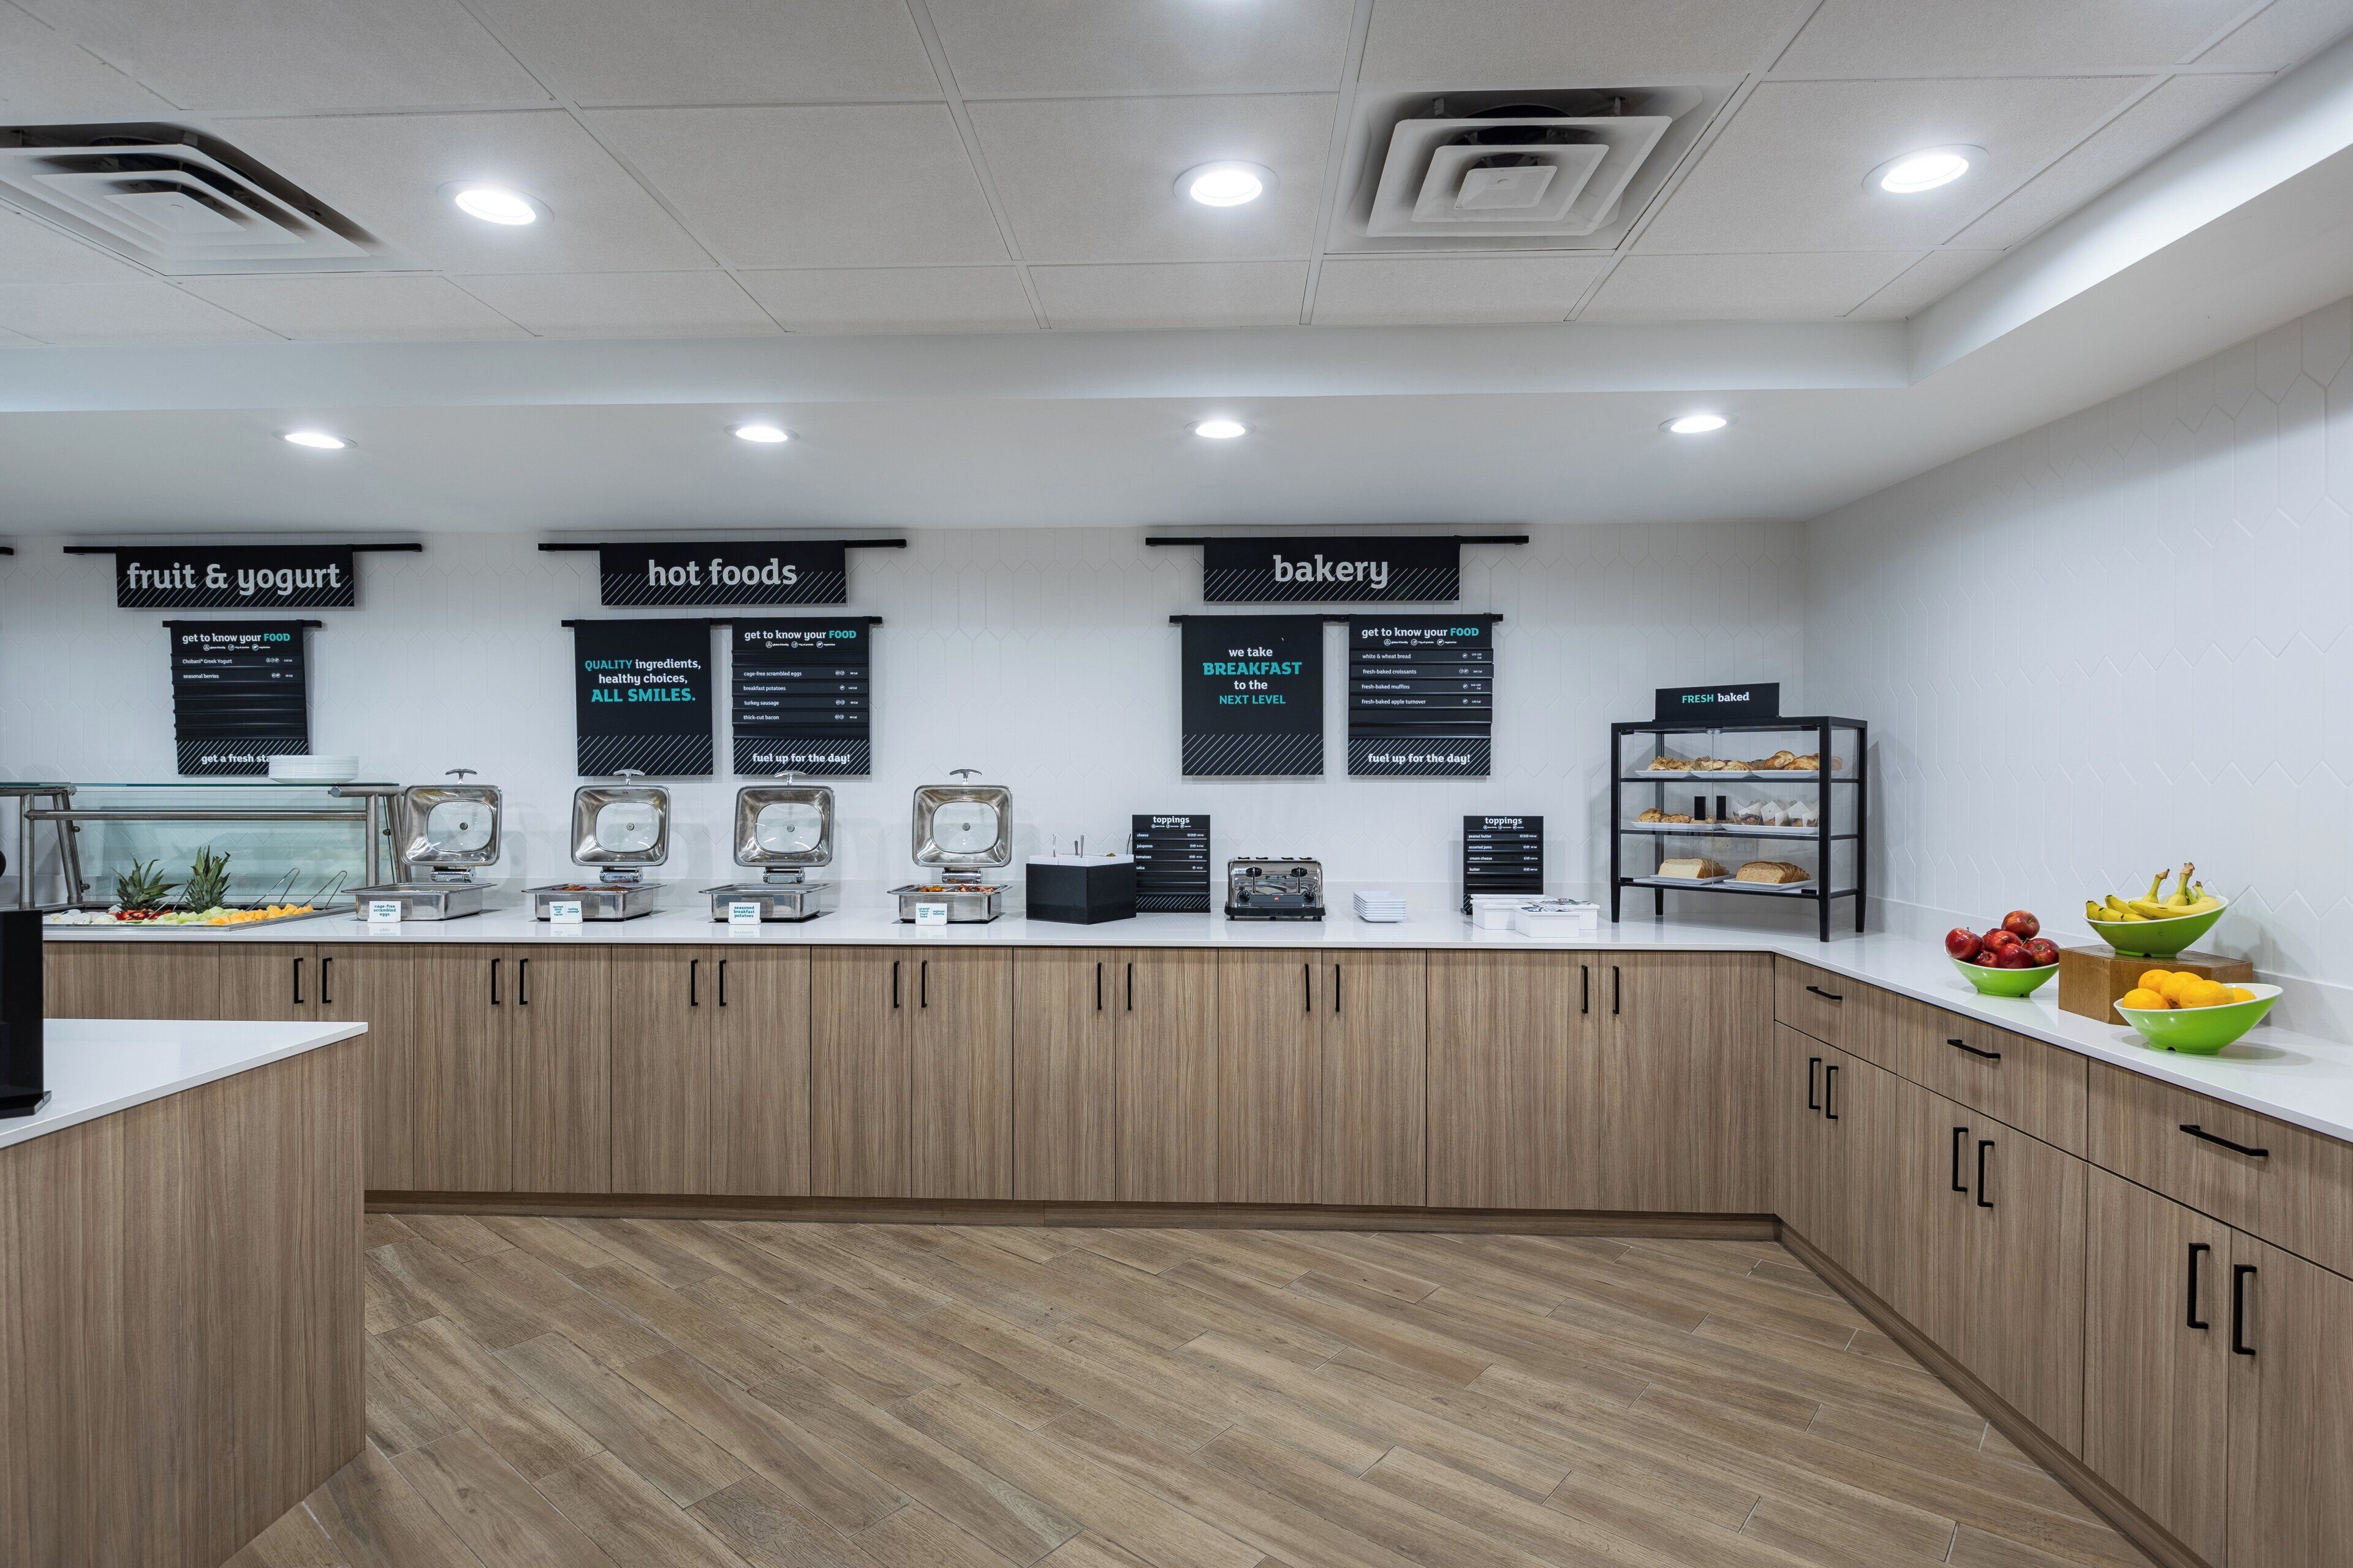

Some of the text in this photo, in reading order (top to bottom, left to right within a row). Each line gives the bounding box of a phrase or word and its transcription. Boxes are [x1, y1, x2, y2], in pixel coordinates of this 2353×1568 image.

[648, 558, 797, 586] hot foods
[1273, 555, 1388, 589] bakery
[127, 562, 341, 596] fruit & yogurt
[745, 631, 761, 641] get
[775, 630, 801, 638] know
[804, 632, 826, 641] your
[1362, 627, 1479, 638] get to know your FOOD
[182, 634, 198, 644] get
[212, 633, 237, 642] know
[239, 635, 261, 644] your
[1247, 647, 1273, 656] take
[585, 659, 701, 671] QUALITY ingredients,
[1203, 662, 1302, 675] BREAKFAST
[599, 673, 688, 686] healthy choices,
[1233, 680, 1268, 689] to the
[591, 688, 695, 702] ALL SMILES.
[1219, 695, 1286, 704] NEXT LEVEL
[1682, 692, 1749, 703] FRESH baked
[201, 755, 218, 764] get
[228, 754, 254, 762] fresh
[752, 753, 850, 764] fuel up for the day!
[1368, 753, 1470, 765] fuel up for the day!
[1153, 816, 1189, 825] toppings
[1485, 817, 1522, 825] toppings
